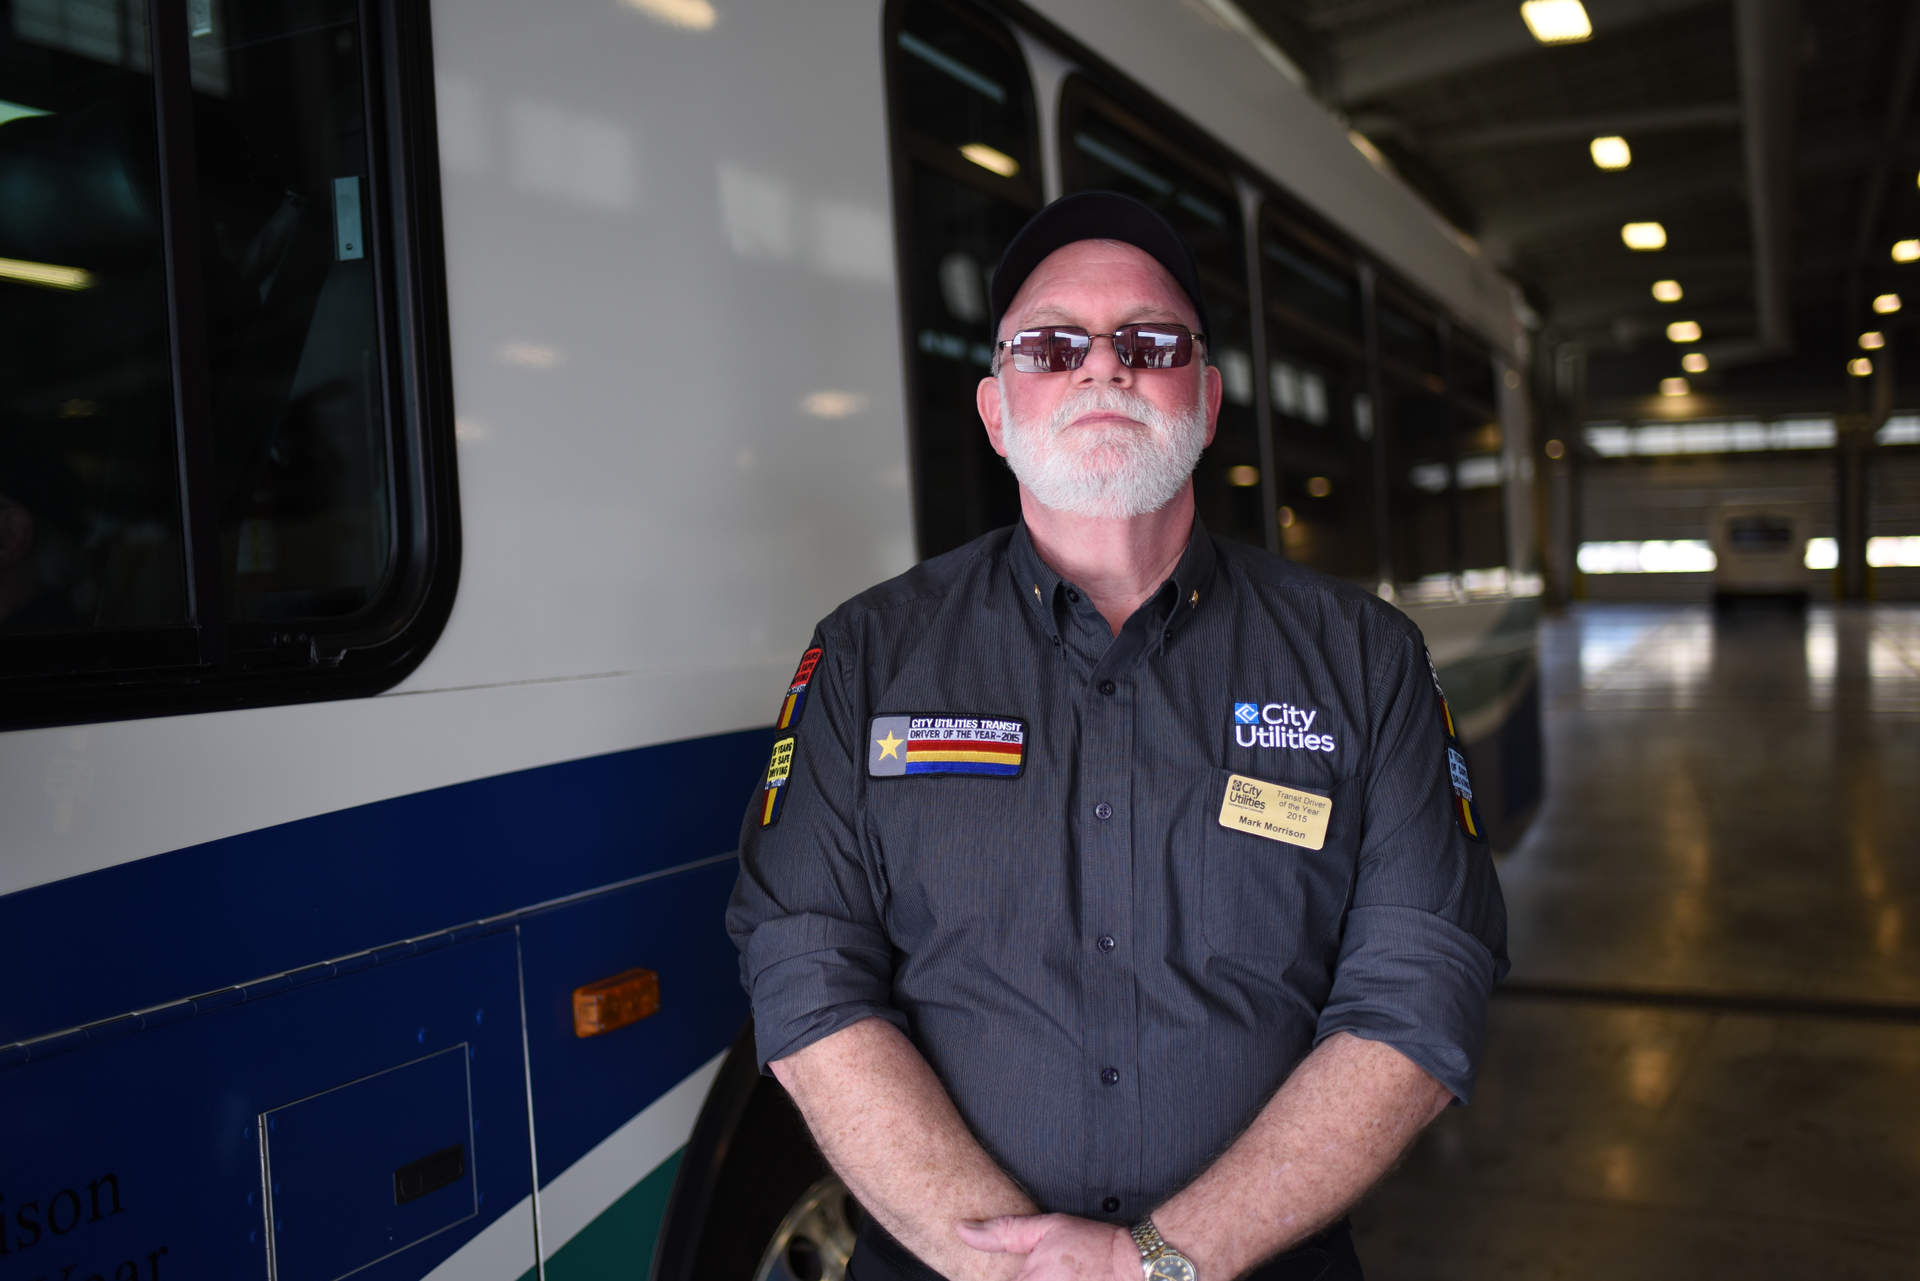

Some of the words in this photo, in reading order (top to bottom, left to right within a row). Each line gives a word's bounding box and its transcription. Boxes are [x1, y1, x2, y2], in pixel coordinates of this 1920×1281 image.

[911, 718, 932, 728] CITY
[934, 718, 979, 729] UTILITIES
[980, 719, 1022, 732] TRANSIT
[1262, 703, 1316, 732] City
[910, 729, 940, 739] DRIVER
[943, 729, 954, 739] OF
[956, 729, 972, 739] THE
[1235, 725, 1335, 752] Utilities
[1242, 783, 1263, 799] City
[1277, 790, 1302, 802] Transit
[1303, 797, 1326, 809] Driver
[1229, 791, 1266, 810] Utilities
[1288, 801, 1300, 812] the
[1302, 806, 1320, 816] Year
[1286, 811, 1308, 823] 2015
[1239, 815, 1262, 828] Mark
[1264, 822, 1306, 839] Morrison
